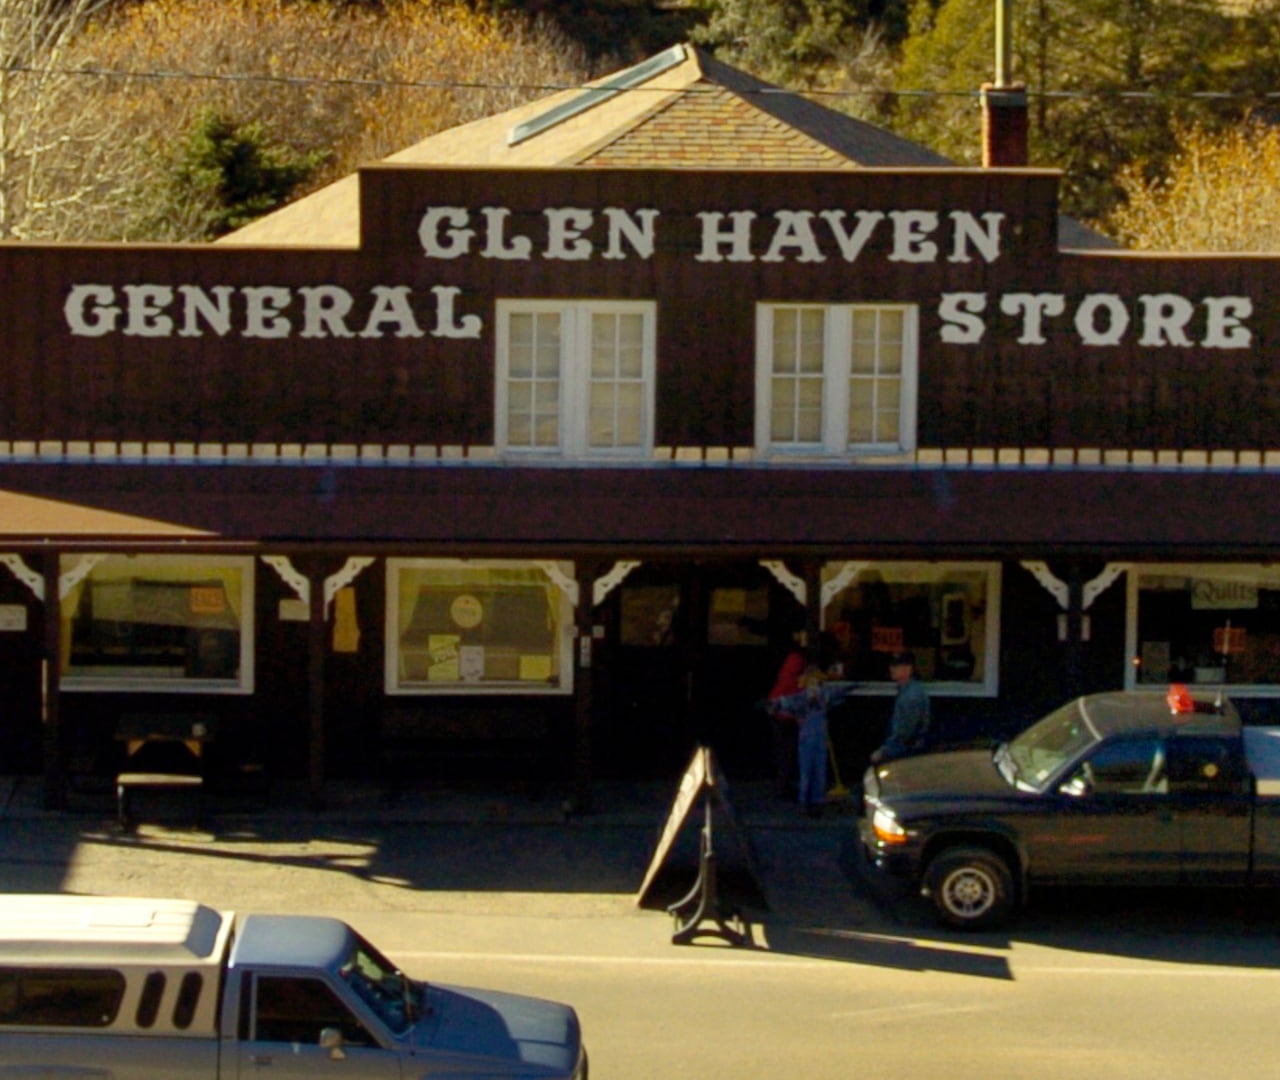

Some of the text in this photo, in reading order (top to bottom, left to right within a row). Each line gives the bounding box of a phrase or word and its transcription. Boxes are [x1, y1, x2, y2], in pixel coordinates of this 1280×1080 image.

[418, 206, 1005, 263] GLEN HAVEN
[64, 284, 482, 339] GENERAL
[938, 291, 1253, 349] STORE
